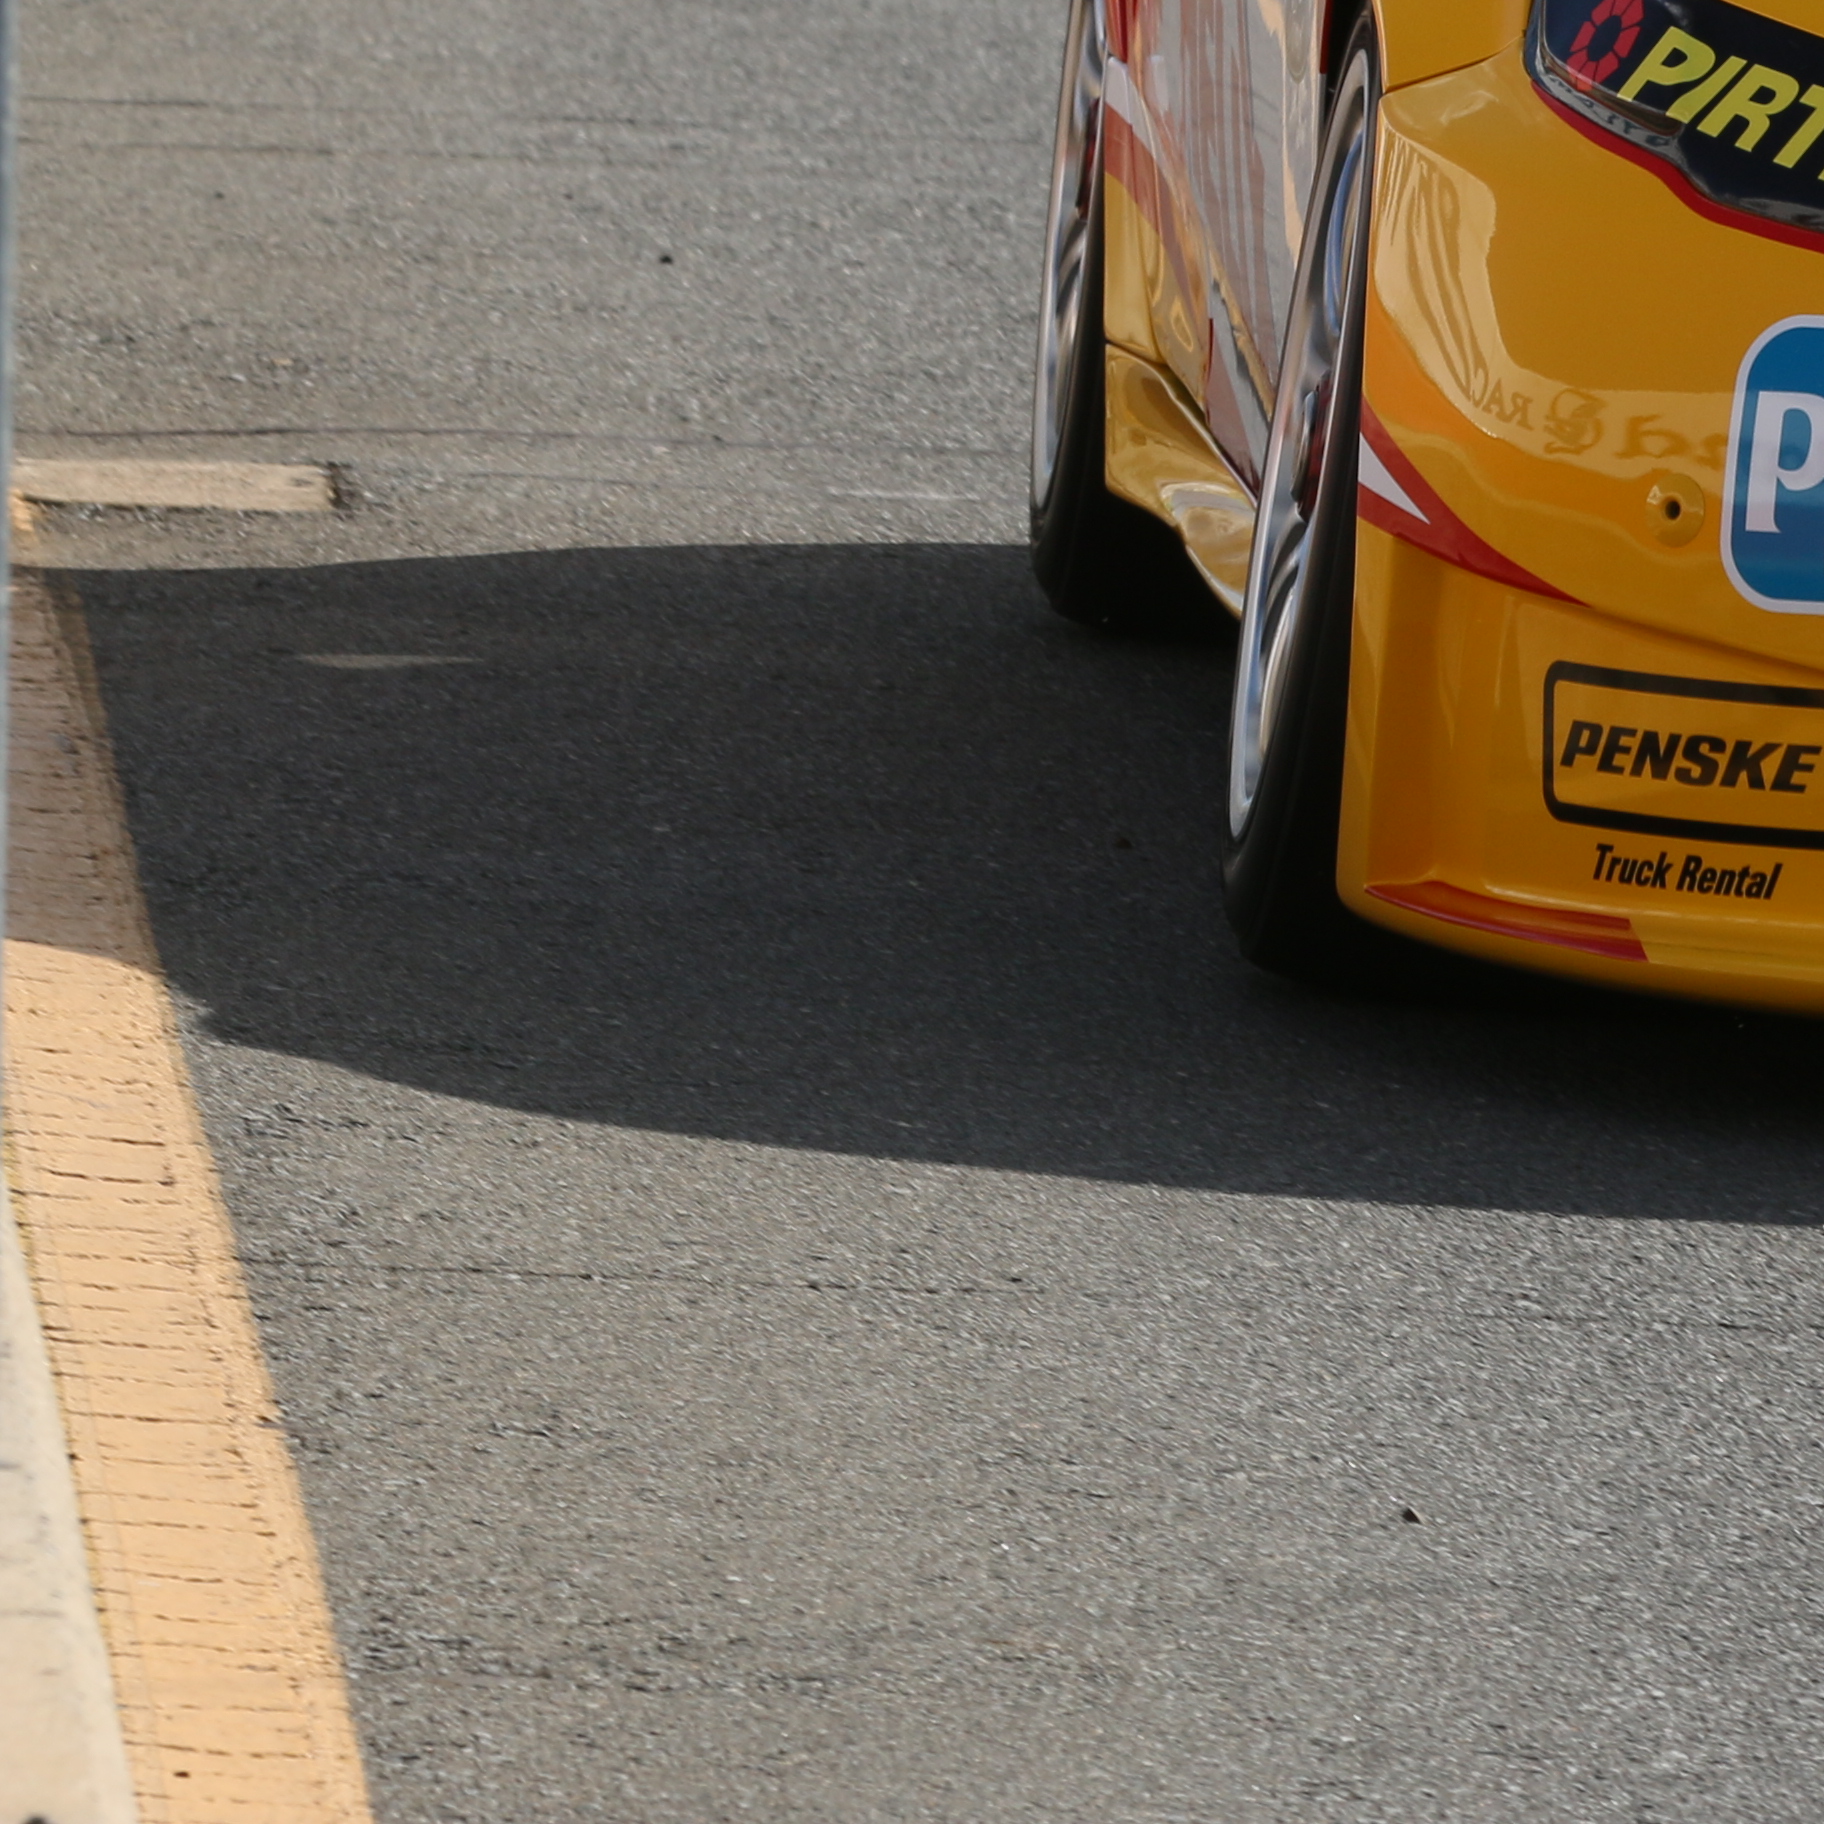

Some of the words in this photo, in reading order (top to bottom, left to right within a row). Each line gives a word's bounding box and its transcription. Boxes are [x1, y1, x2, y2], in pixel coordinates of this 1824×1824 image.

[1560, 719, 1822, 794] PENSKE
[1593, 842, 1673, 890] Truck
[1675, 853, 1784, 900] Rental
